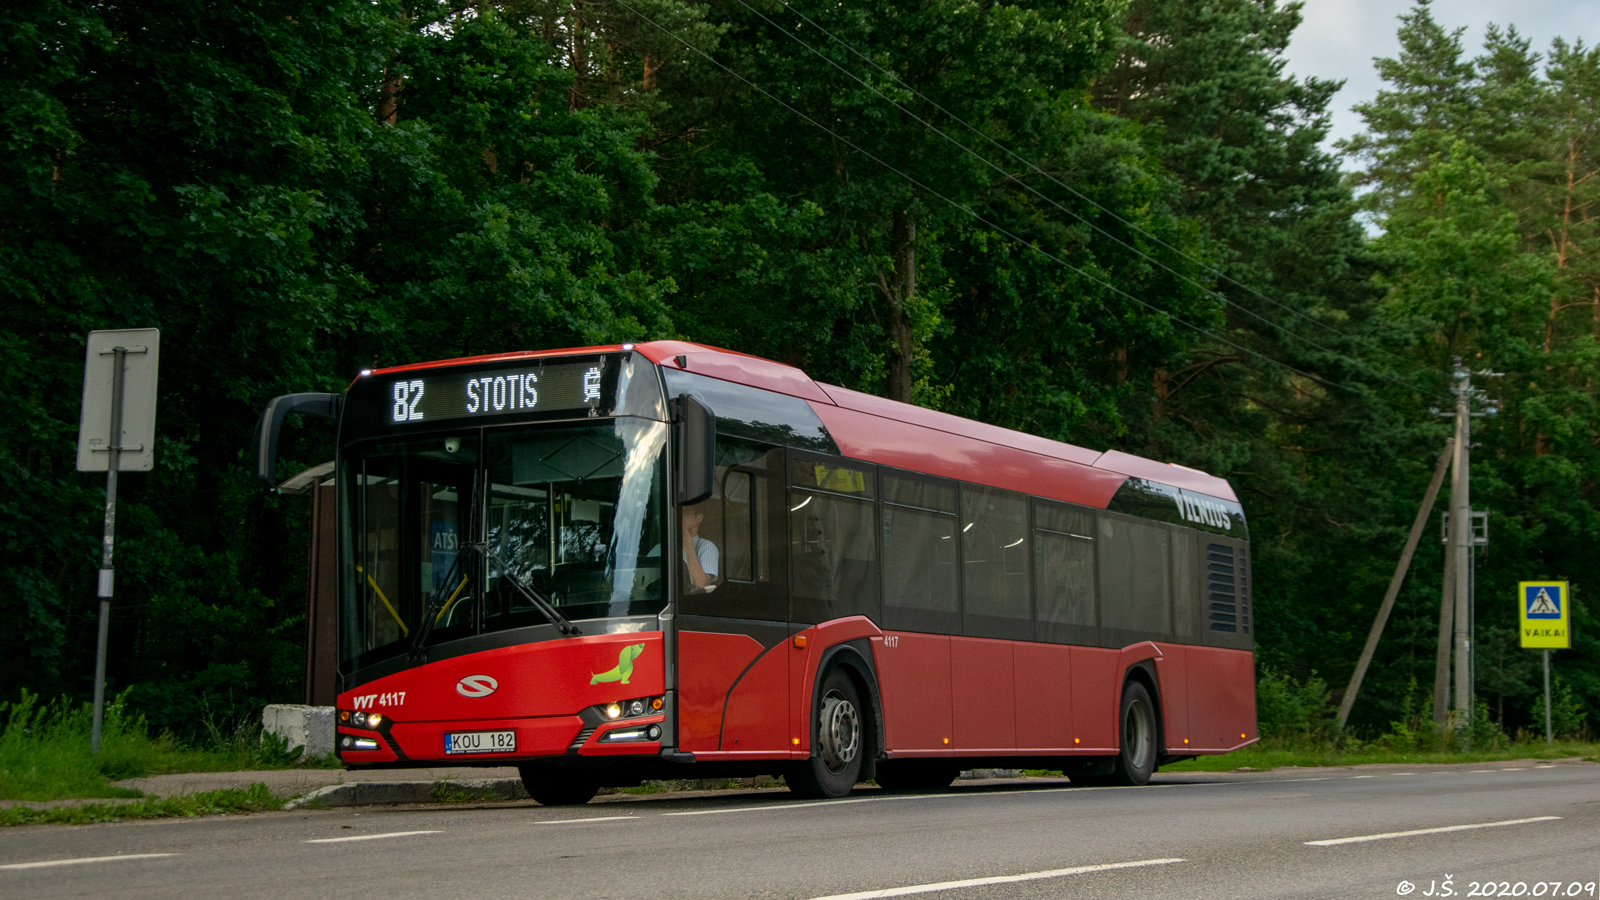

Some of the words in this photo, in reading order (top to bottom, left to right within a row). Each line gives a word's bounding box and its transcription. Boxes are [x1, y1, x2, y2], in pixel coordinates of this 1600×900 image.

[392, 379, 425, 422] 82
[466, 373, 538, 413] STOTIS
[1174, 493, 1232, 530] VILNIUS
[1524, 628, 1565, 637] VAIKAI
[884, 635, 899, 648] 4117
[379, 691, 406, 707] 4117
[453, 734, 481, 749] KOU
[490, 733, 513, 747] 182
